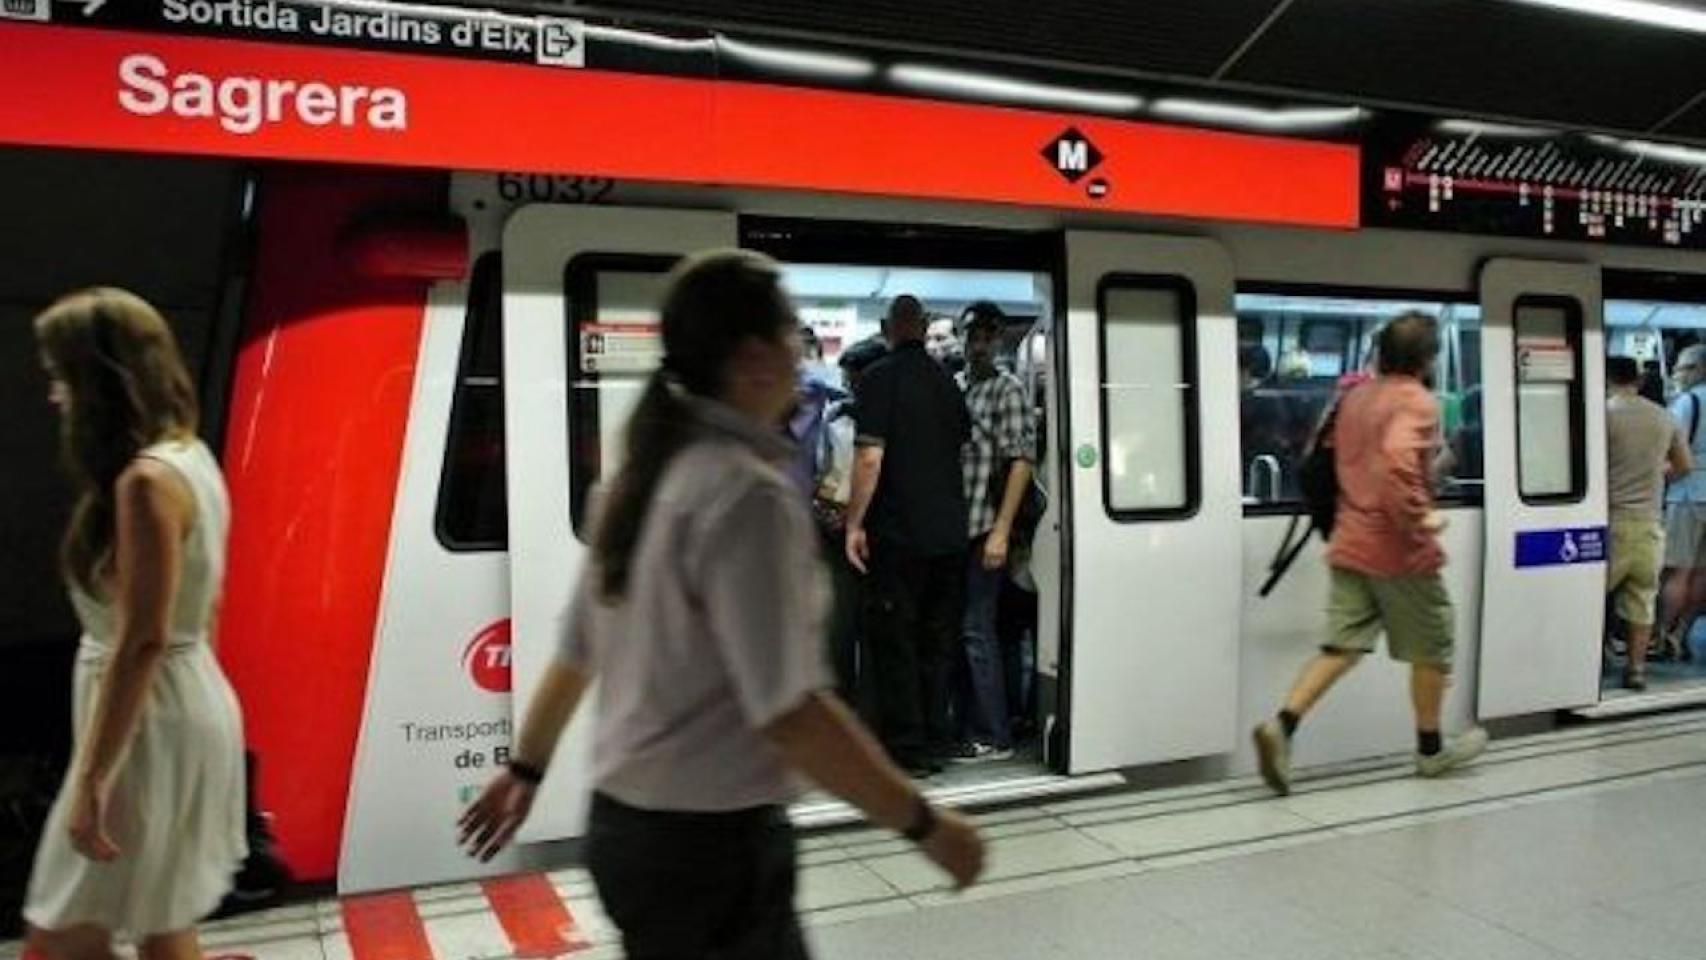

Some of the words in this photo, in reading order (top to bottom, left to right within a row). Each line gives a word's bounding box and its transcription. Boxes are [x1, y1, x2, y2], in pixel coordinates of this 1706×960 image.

[163, 0, 298, 31] Sortida
[310, 5, 441, 45] Jardins
[118, 53, 407, 134] Sagrera
[1058, 139, 1087, 170] M
[498, 170, 615, 204] 6032
[402, 718, 511, 742] Transport
[455, 750, 485, 768] de
